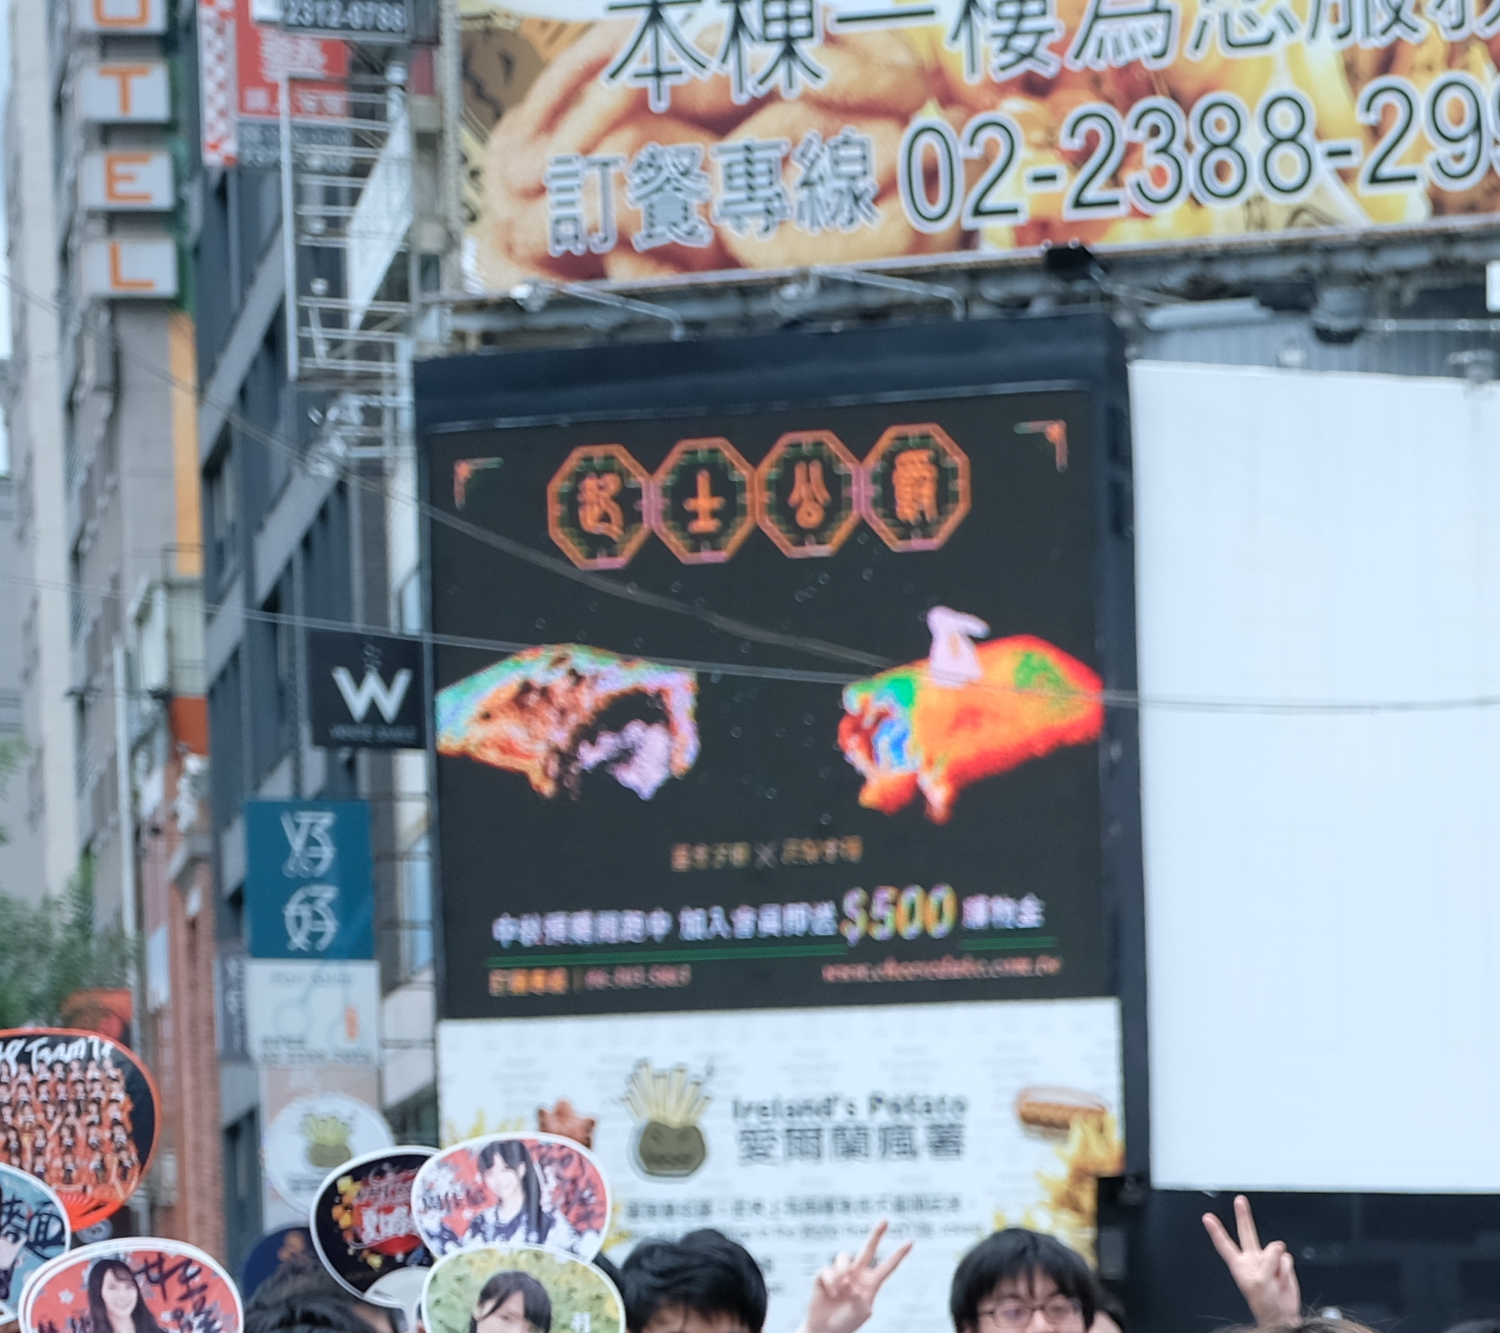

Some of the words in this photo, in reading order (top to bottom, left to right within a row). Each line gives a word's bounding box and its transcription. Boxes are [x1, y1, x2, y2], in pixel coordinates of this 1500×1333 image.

[543, 133, 882, 257] 訂餐專線
[333, 666, 412, 722] W
[838, 882, 957, 946] $500
[732, 1097, 858, 1121] Ireland's
[868, 1097, 970, 1119] Potato
[738, 1124, 967, 1166] 愛爾蘭瘋薯
